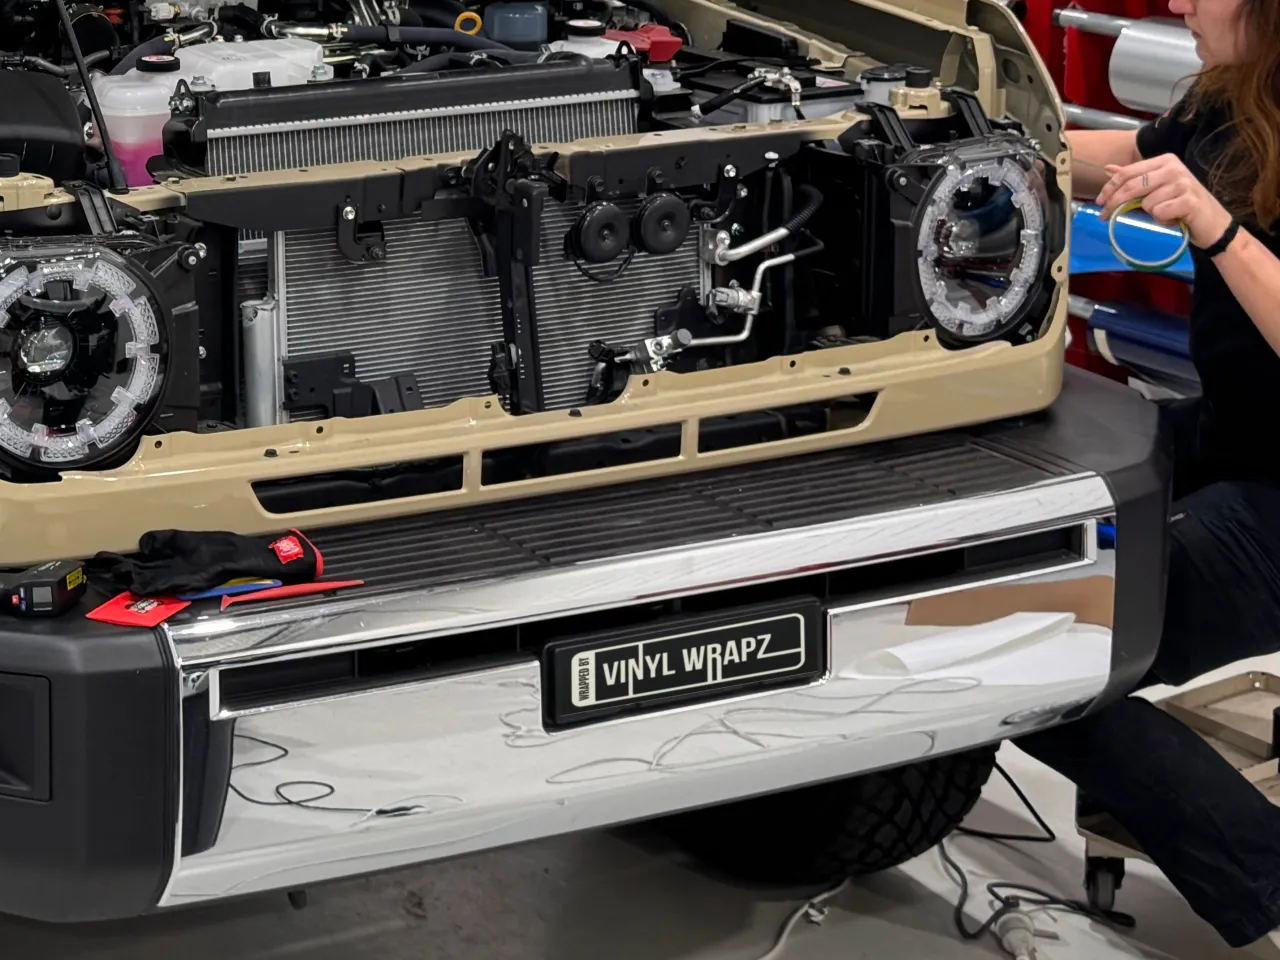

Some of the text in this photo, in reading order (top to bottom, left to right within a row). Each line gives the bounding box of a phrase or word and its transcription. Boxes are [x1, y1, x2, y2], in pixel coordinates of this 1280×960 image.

[578, 656, 590, 702] WRAPPED BY
[602, 633, 772, 696] VINYL WRAPZ
